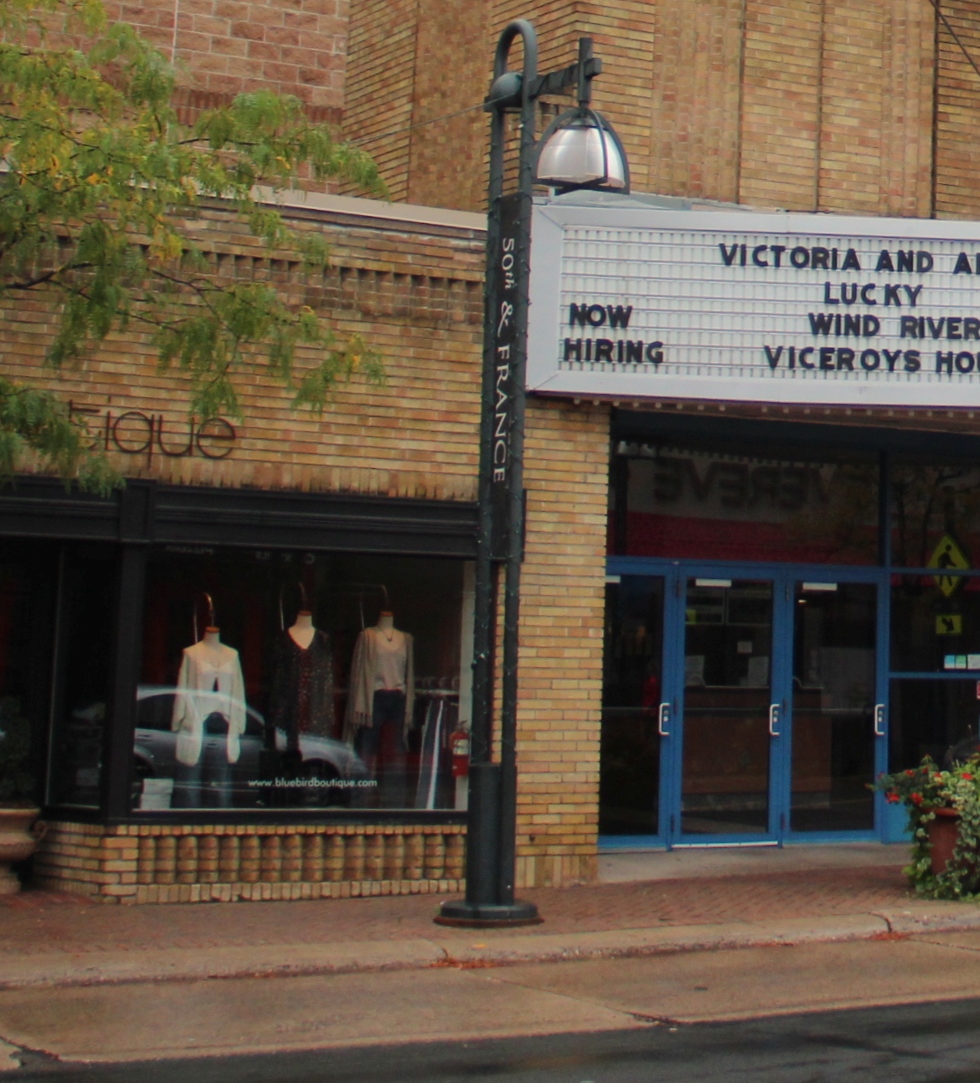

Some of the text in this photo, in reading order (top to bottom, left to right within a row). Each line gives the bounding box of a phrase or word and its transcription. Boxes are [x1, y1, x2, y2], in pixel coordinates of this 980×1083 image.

[719, 243, 861, 271] VICTORIA
[875, 249, 934, 274] AND
[824, 282, 923, 307] LUCKY
[570, 303, 633, 328] NOW
[808, 313, 880, 337] WIND
[493, 237, 516, 483] 50th & FRANCE
[564, 338, 663, 364] HIRING
[764, 345, 921, 372] VICEROYS
[248, 776, 378, 790] www.bluebirdboutique.com
